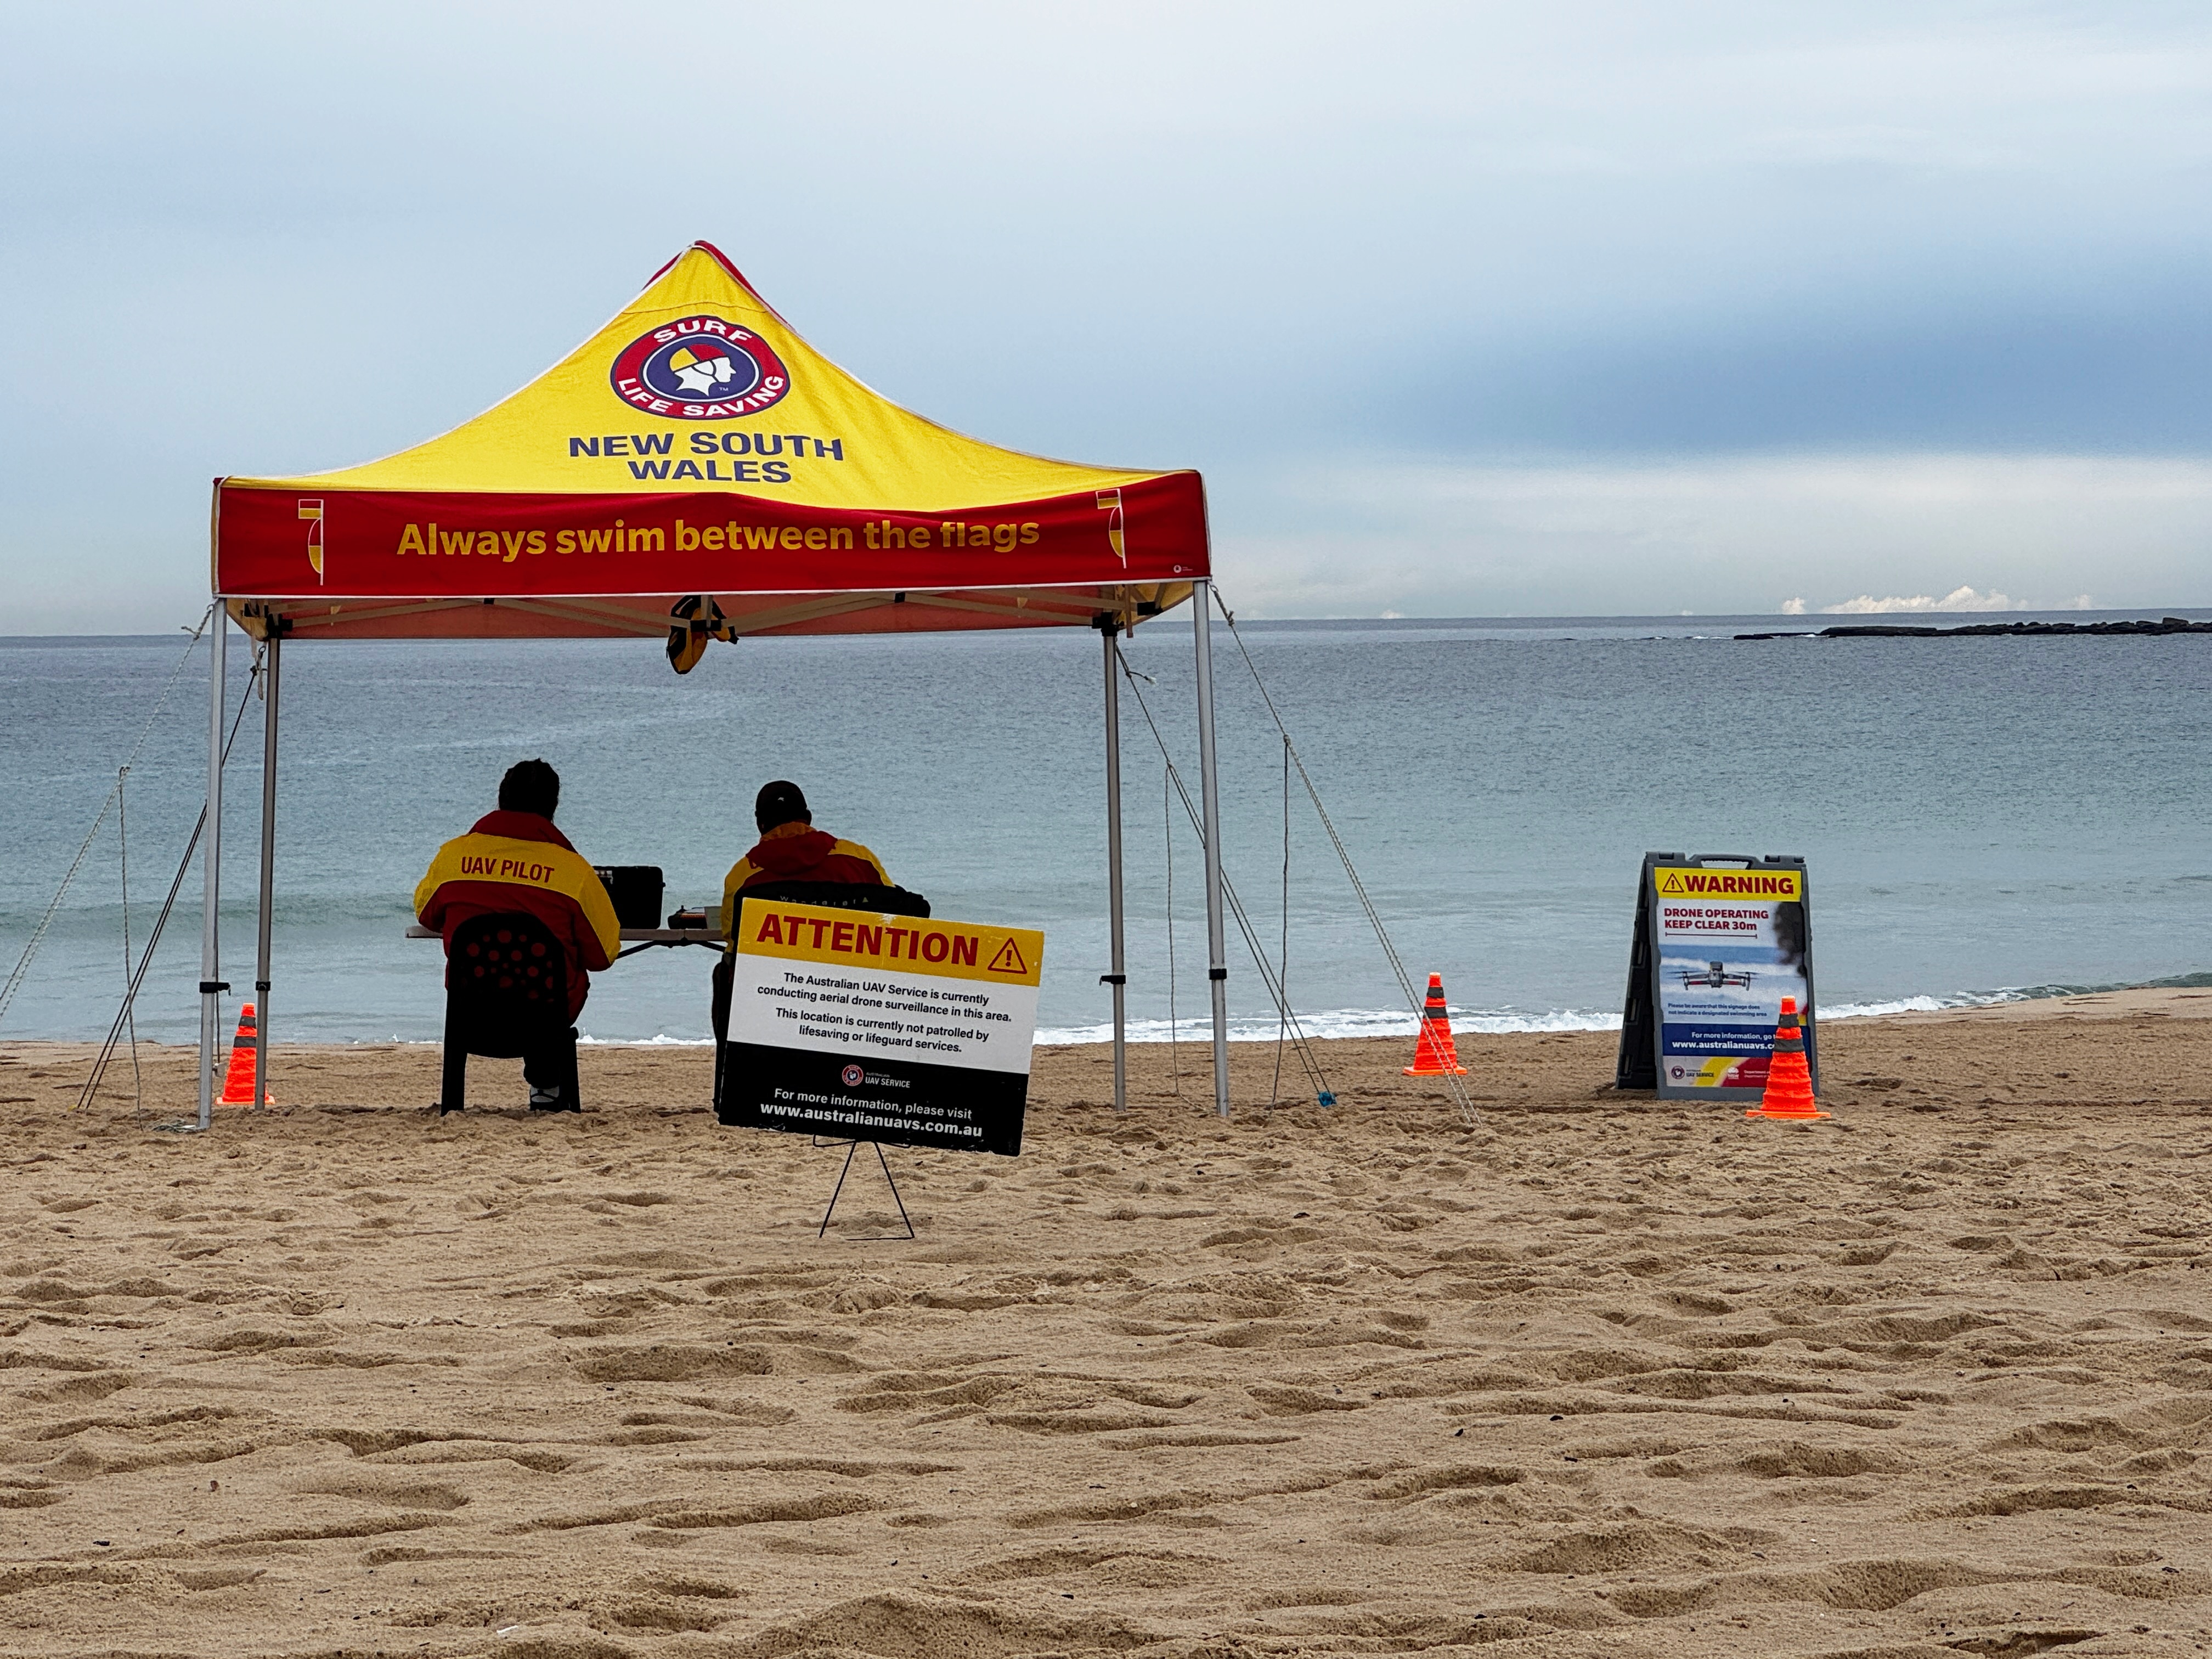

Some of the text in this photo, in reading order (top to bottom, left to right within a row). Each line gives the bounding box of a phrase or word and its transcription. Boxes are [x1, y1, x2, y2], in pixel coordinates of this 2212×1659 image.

[654, 320, 752, 342] SURF
[618, 376, 783, 416] LIFE SAVING
[569, 432, 843, 460] NEW SOUTH
[628, 460, 791, 483] WALES
[397, 519, 1039, 562] Always swim between the flags
[461, 856, 555, 883] UAV PILOT
[1684, 875, 1793, 894] WARNING
[1664, 908, 1769, 919] DRONE OPERATING
[1664, 919, 1757, 930] KEEP CLEAR 30m
[757, 913, 979, 966] ATTENTION
[784, 972, 989, 1006] The Australian UAV Service is currently
[758, 986, 1011, 1022] conducting aerial drone surveillance in this area.
[776, 1007, 989, 1042] This location is currently not patrolled by
[799, 1025, 962, 1052] lifesaving or lifeguard services.
[865, 1076, 911, 1088] UAV SERVICE
[775, 1088, 972, 1119] For more information, please visit
[760, 1104, 982, 1137] www.australianuavs.com.au
